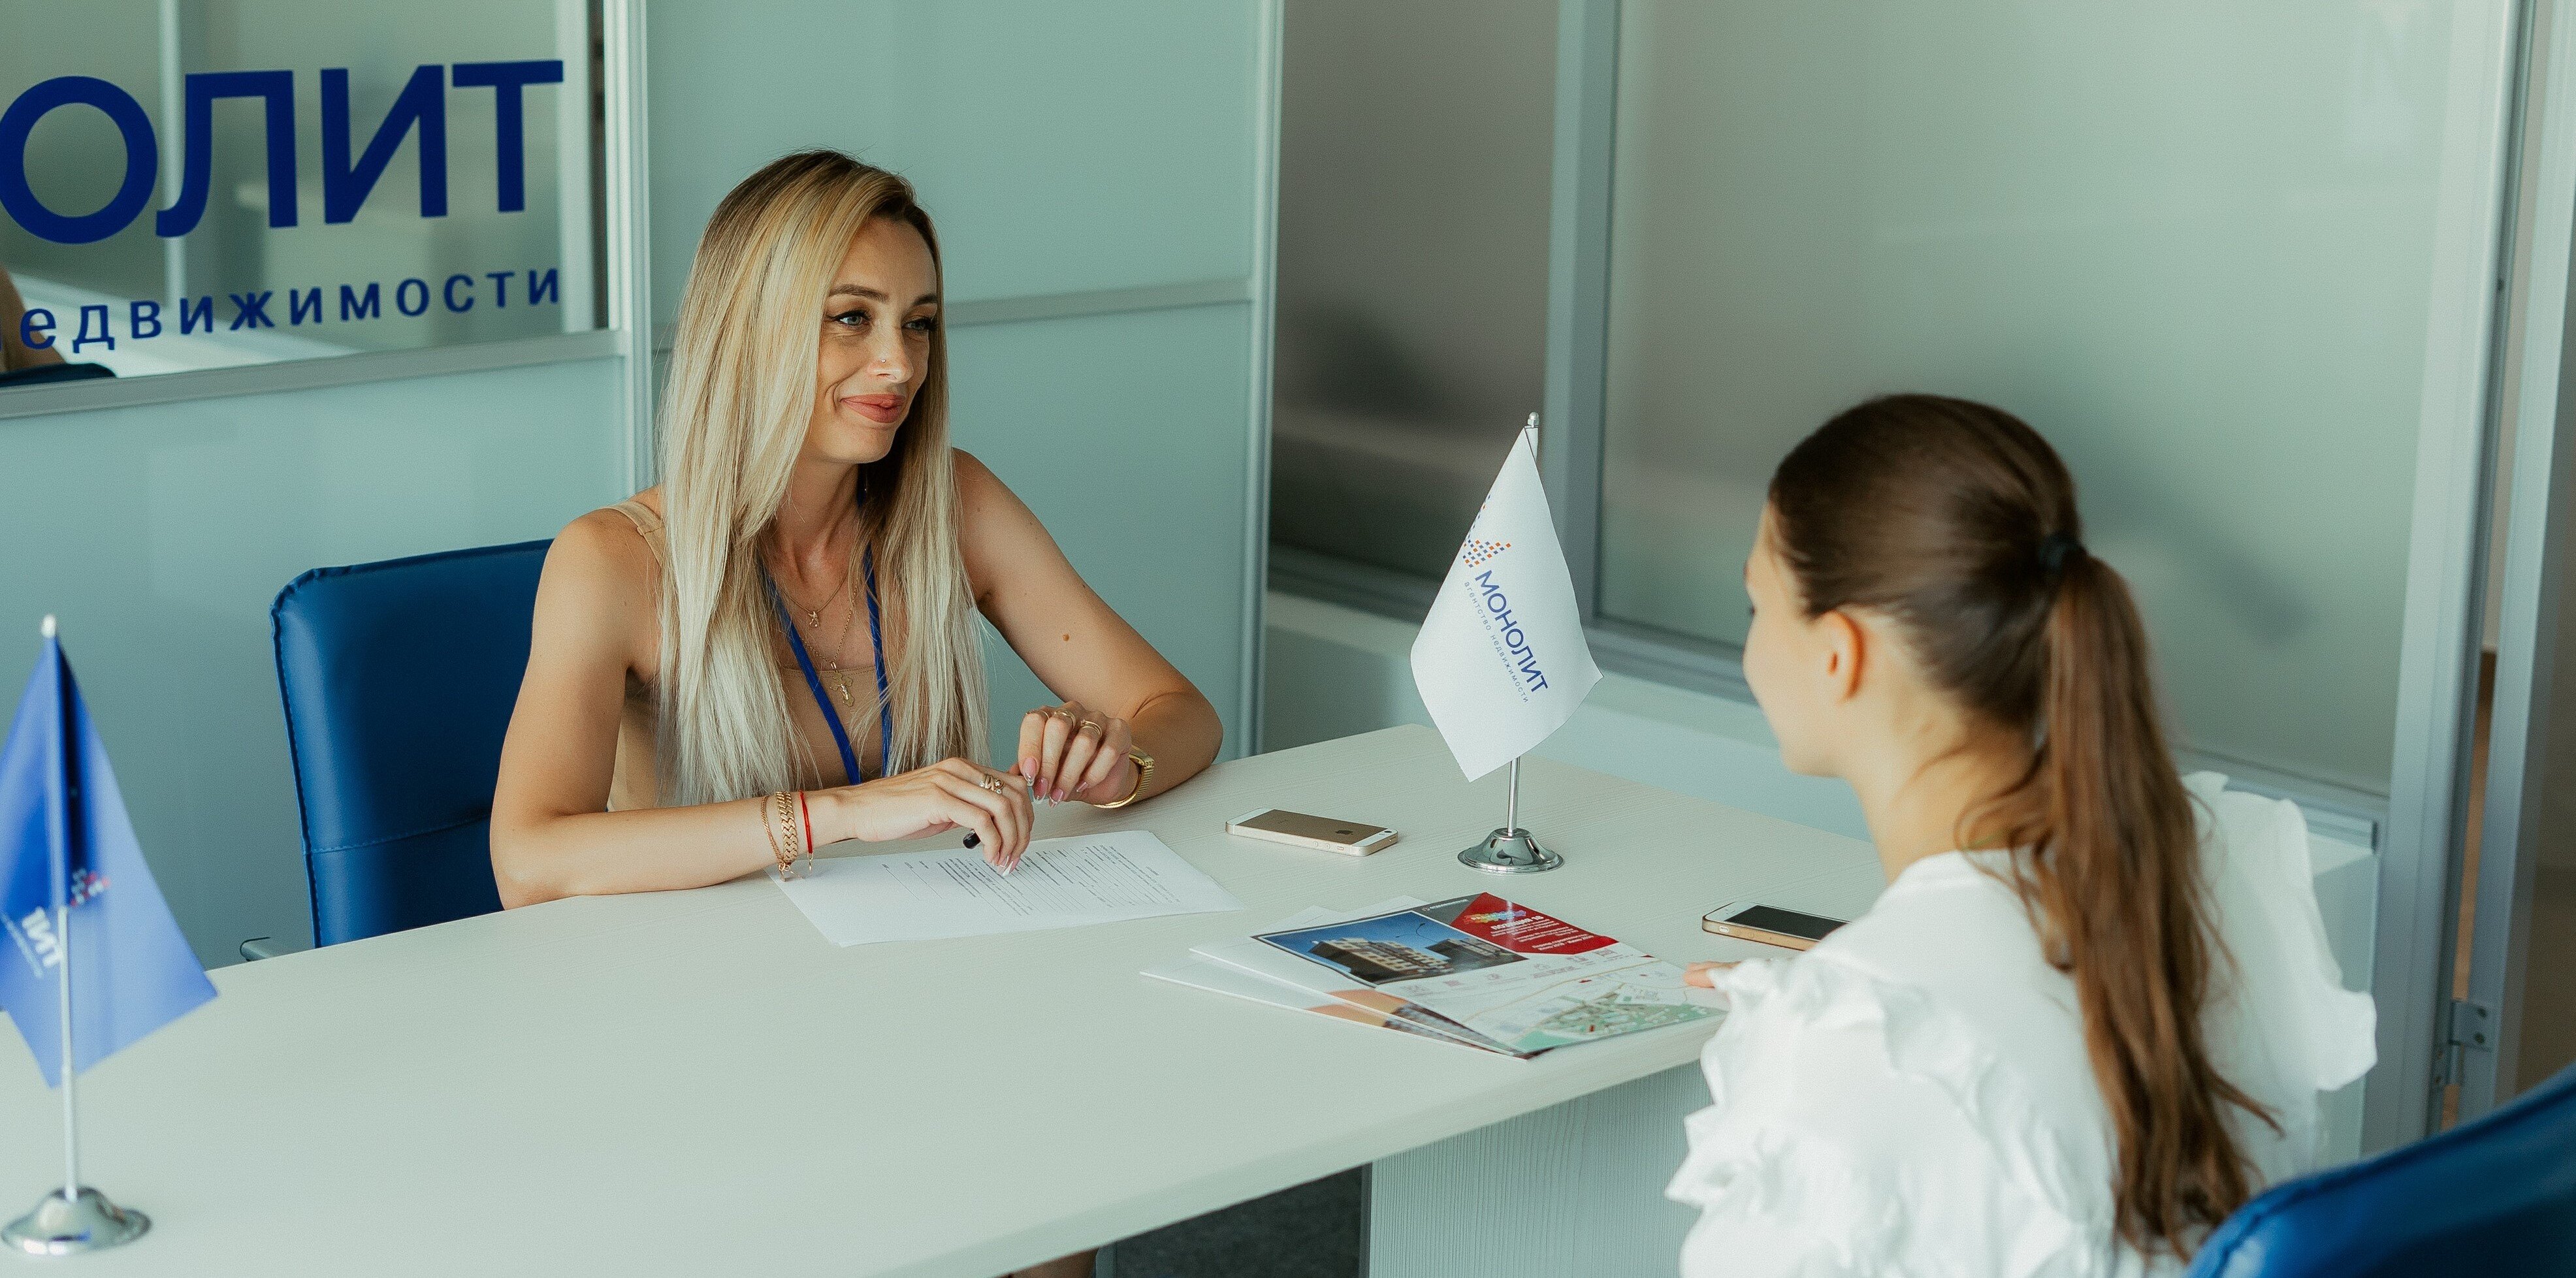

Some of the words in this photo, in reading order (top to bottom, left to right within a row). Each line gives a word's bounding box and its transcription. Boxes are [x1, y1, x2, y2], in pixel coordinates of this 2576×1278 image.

[0, 60, 564, 244] ОЛИТ
[0, 268, 560, 354] едвижимости
[1464, 581, 1492, 631] агентство
[1490, 634, 1528, 703] недвижимости
[1475, 569, 1549, 693] МОНОЛИТ
